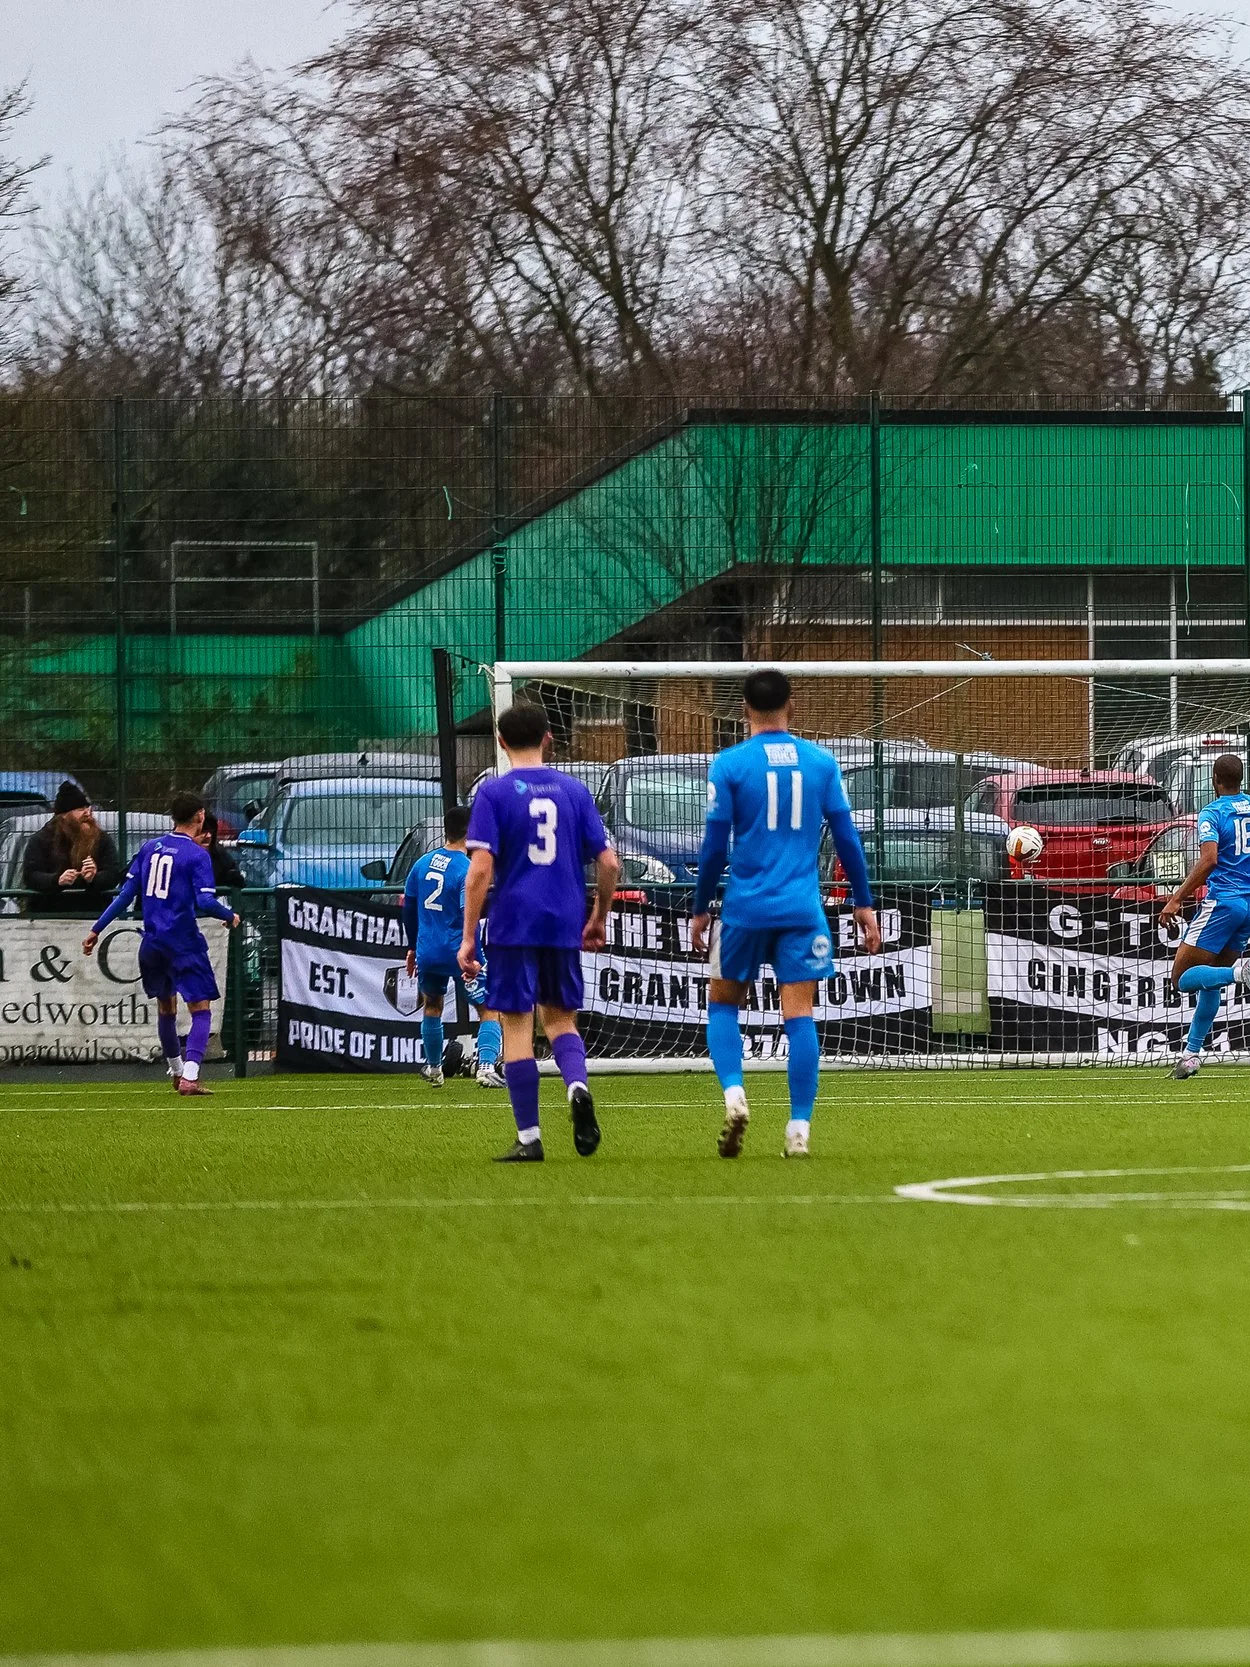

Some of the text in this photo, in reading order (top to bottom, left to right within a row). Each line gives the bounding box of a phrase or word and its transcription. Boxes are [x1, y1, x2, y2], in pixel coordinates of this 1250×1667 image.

[766, 771, 802, 831] 11
[528, 798, 558, 866] 3
[146, 853, 174, 899] 10
[424, 872, 444, 911] 2
[287, 896, 408, 947] GRANTHA
[606, 911, 663, 950] THE
[30, 945, 73, 983] &
[98, 928, 146, 984] C
[309, 961, 354, 1000] EST.
[599, 967, 780, 1010] GRANTAM
[1, 993, 150, 1026] edworth
[288, 1019, 346, 1055] PRIDE
[349, 1030, 376, 1060] OF
[1098, 1027, 1231, 1052] NG1
